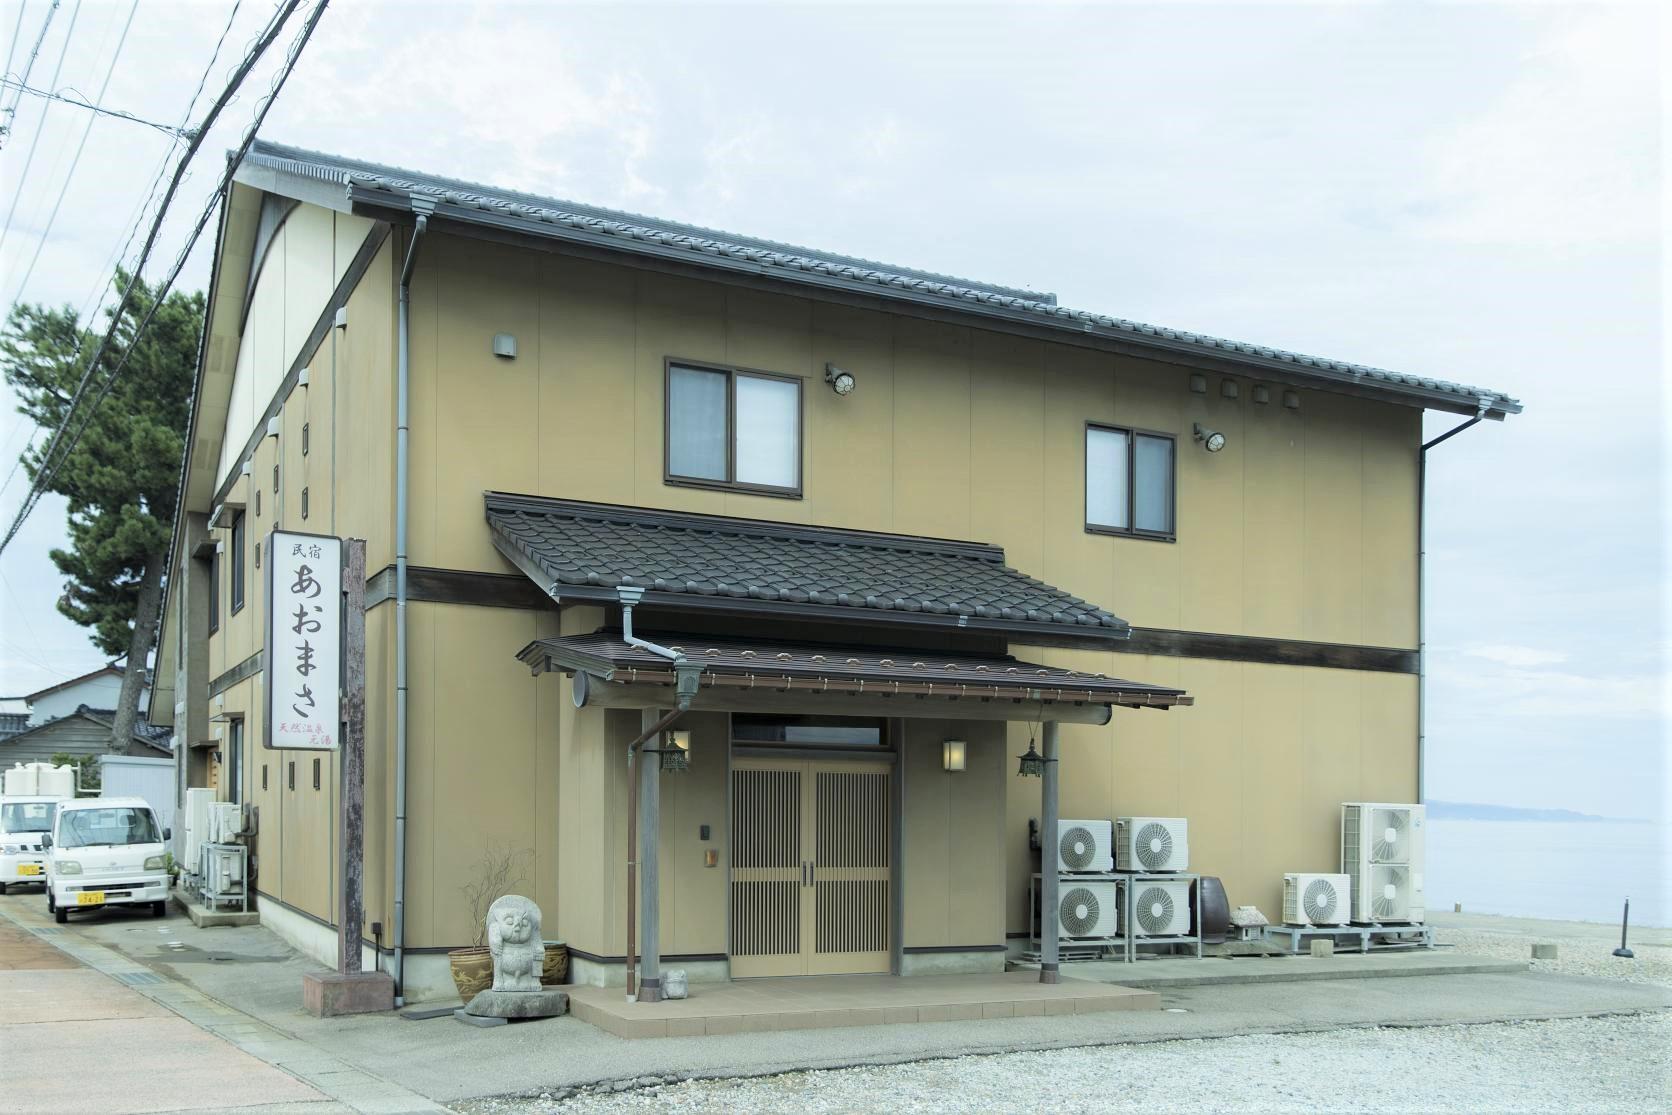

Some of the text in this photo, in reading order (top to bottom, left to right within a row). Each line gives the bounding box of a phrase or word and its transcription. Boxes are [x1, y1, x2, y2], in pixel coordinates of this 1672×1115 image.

[292, 543, 322, 559] 民宿
[290, 564, 323, 718] あおまさ
